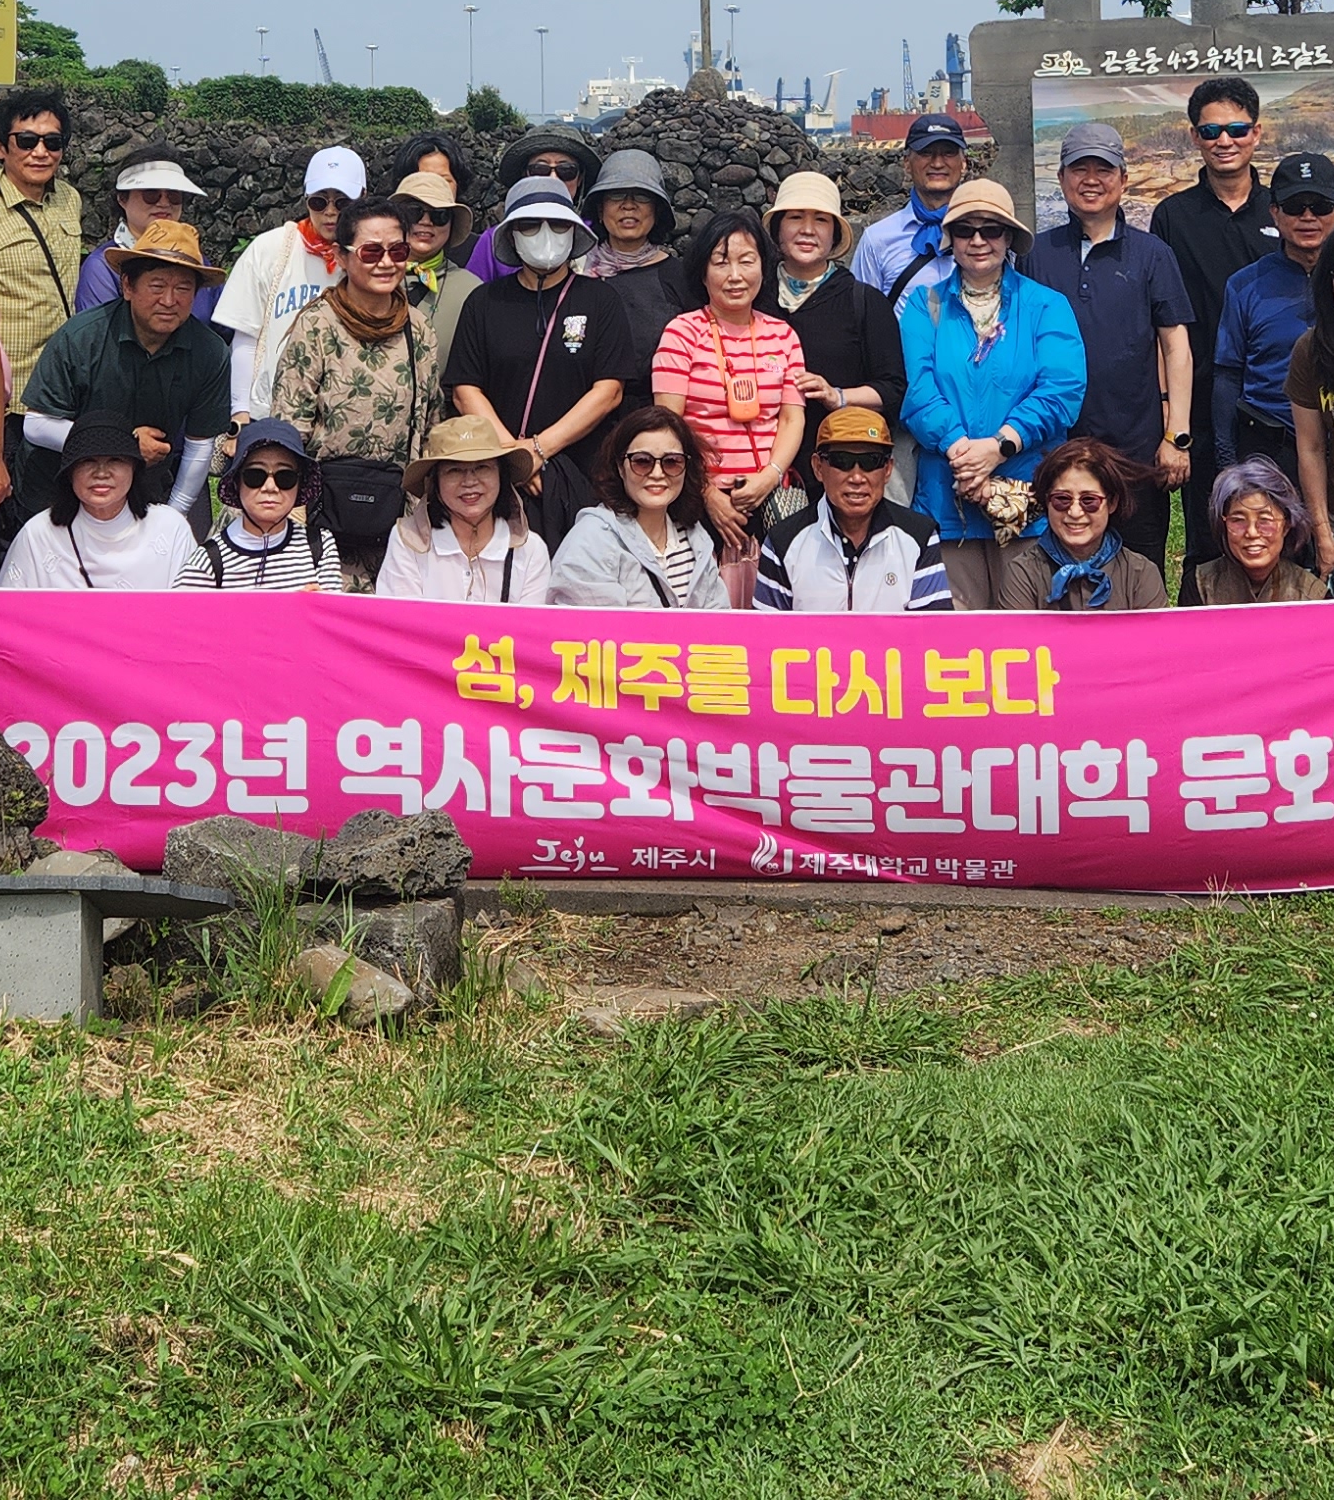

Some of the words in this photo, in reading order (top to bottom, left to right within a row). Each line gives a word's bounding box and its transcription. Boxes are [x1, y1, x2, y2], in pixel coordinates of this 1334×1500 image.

[1100, 46, 1163, 74] 곤을동
[1270, 42, 1333, 70] 조감도
[453, 634, 535, 710] 섬,
[551, 639, 751, 715] 제주를
[770, 647, 903, 719] 다시
[922, 646, 1060, 717] 보다
[4, 716, 309, 814] 2023년
[336, 717, 1158, 835] 역사문화박물관대학
[534, 837, 607, 872] Jeju
[632, 847, 716, 871] 제주시
[799, 853, 929, 878] 제주대학교
[935, 856, 1017, 880] 박물관
